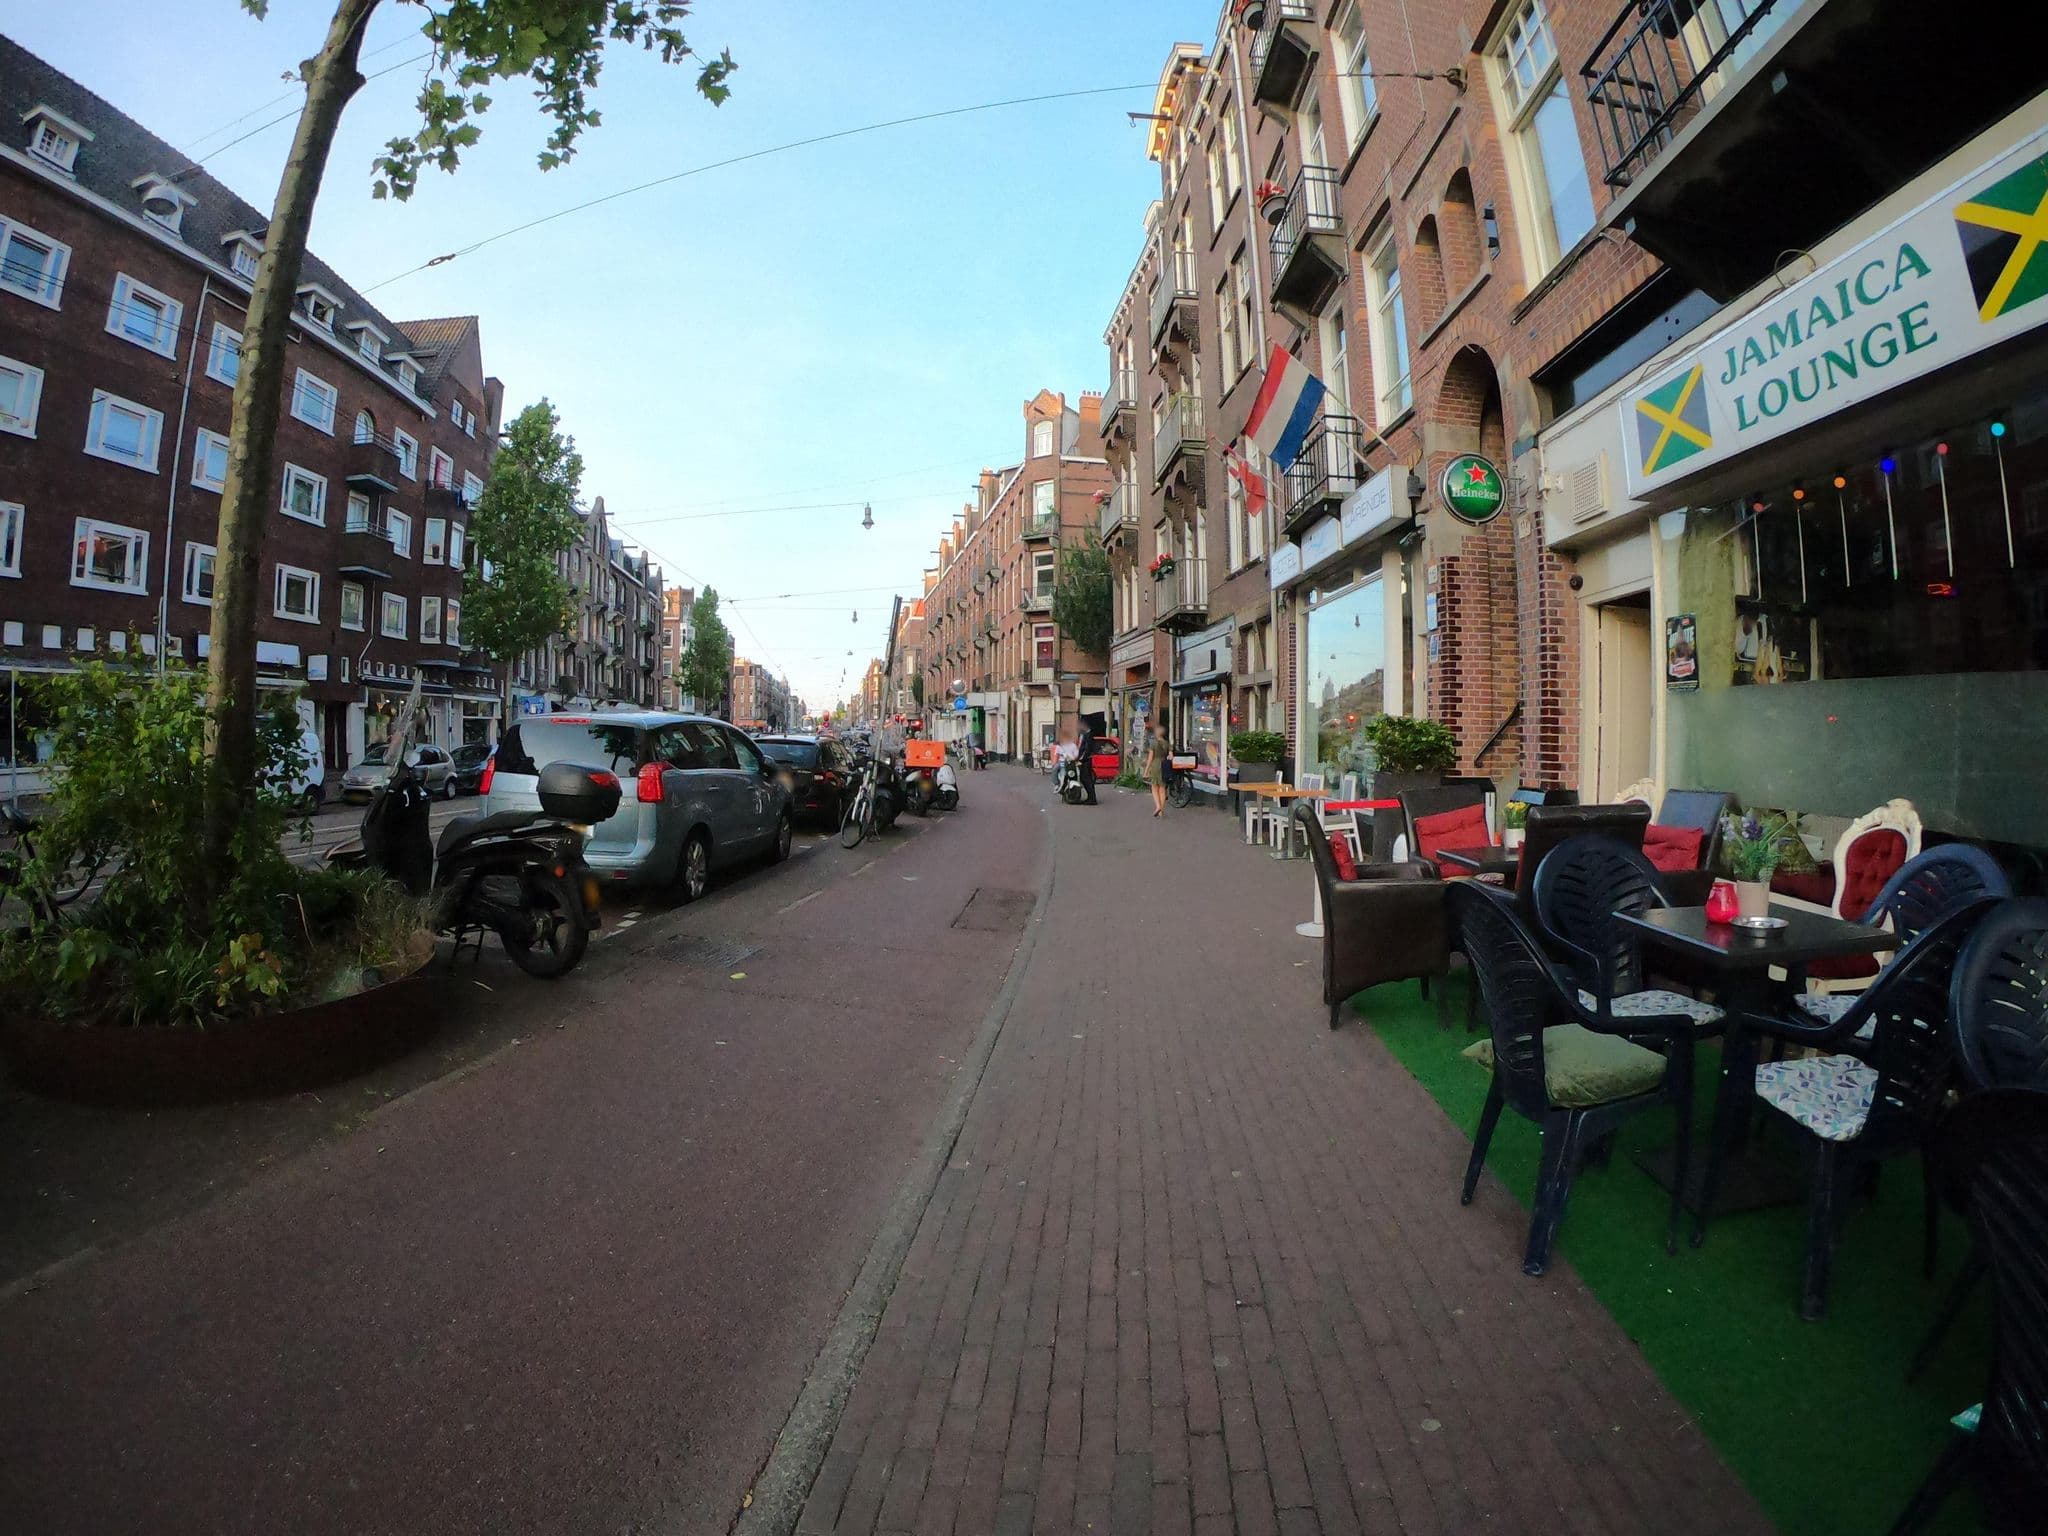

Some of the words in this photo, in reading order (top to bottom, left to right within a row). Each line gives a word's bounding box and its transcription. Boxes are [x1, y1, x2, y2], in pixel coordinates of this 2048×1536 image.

[1721, 242, 1932, 385] JAMAICA
[1733, 301, 1938, 432] LOUNGE
[1451, 487, 1500, 501] Heineken
